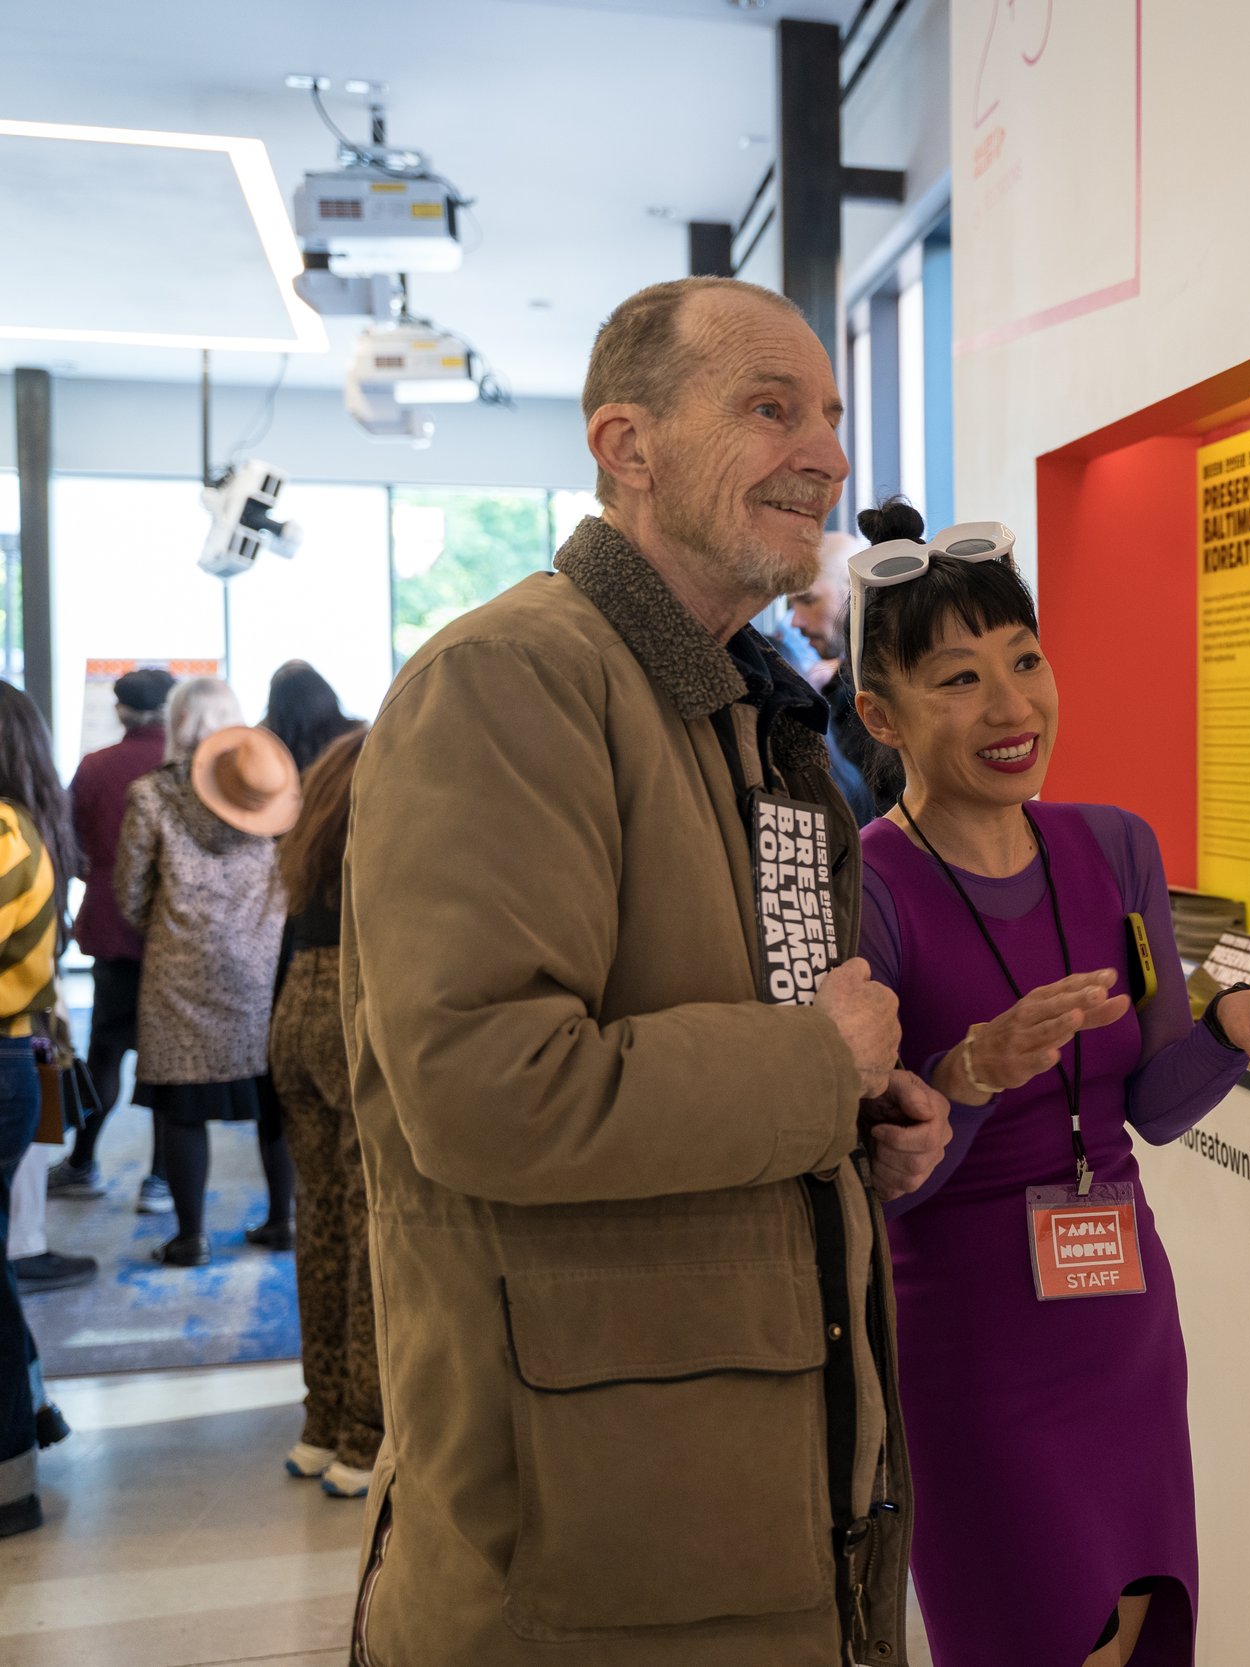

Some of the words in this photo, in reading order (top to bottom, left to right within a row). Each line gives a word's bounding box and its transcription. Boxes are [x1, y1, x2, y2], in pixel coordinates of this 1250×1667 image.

[759, 802, 797, 1006] KOREATO
[1068, 1221, 1106, 1237] ASIA
[1061, 1242, 1117, 1258] NORTH
[1066, 1271, 1119, 1289] STAFF
